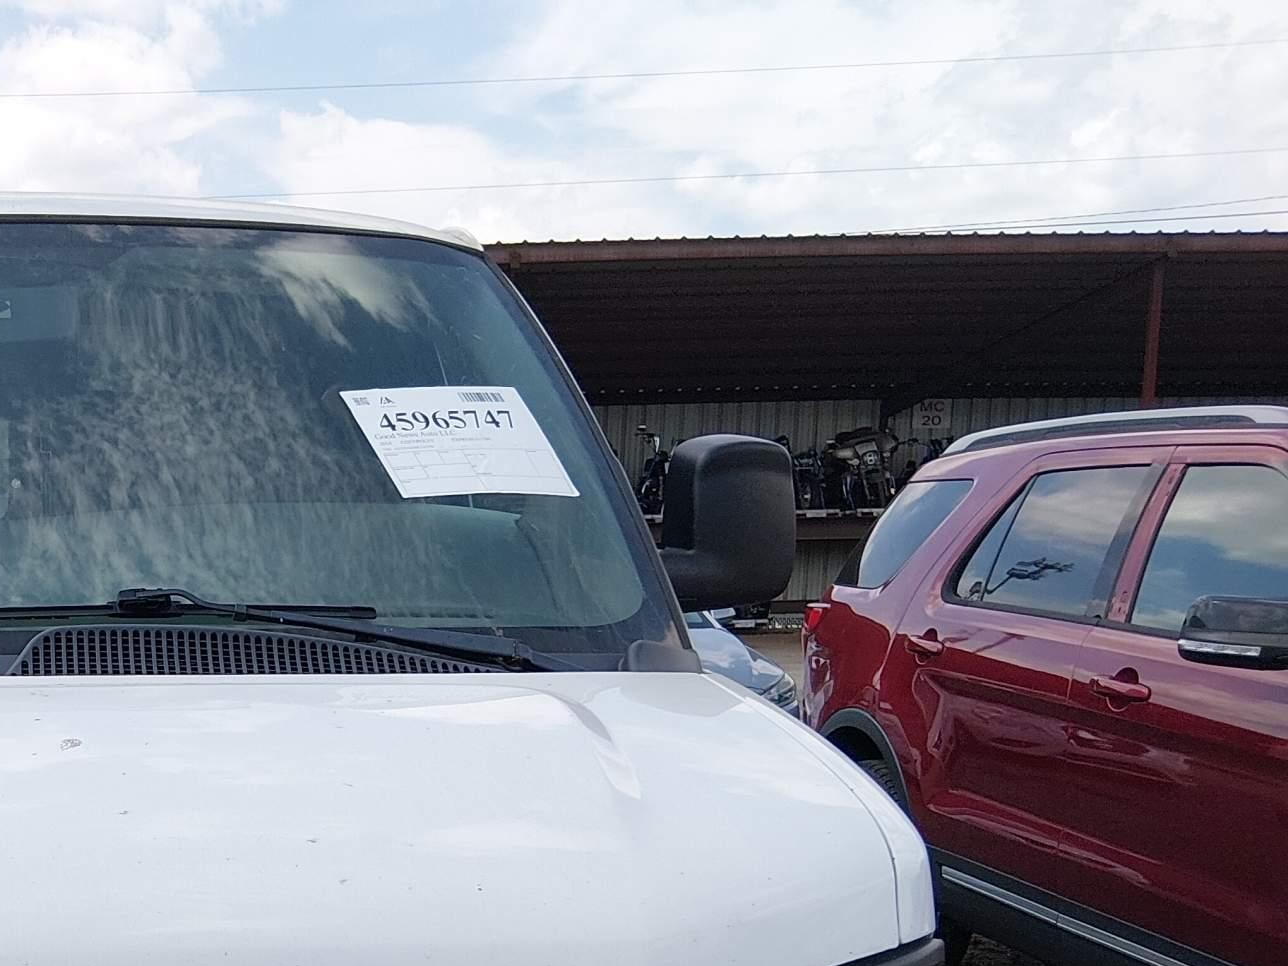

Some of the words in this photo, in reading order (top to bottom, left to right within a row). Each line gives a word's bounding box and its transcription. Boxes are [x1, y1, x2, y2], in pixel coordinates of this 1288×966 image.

[920, 398, 945, 412] MC
[379, 409, 513, 431] 45965747
[921, 415, 942, 426] 20
